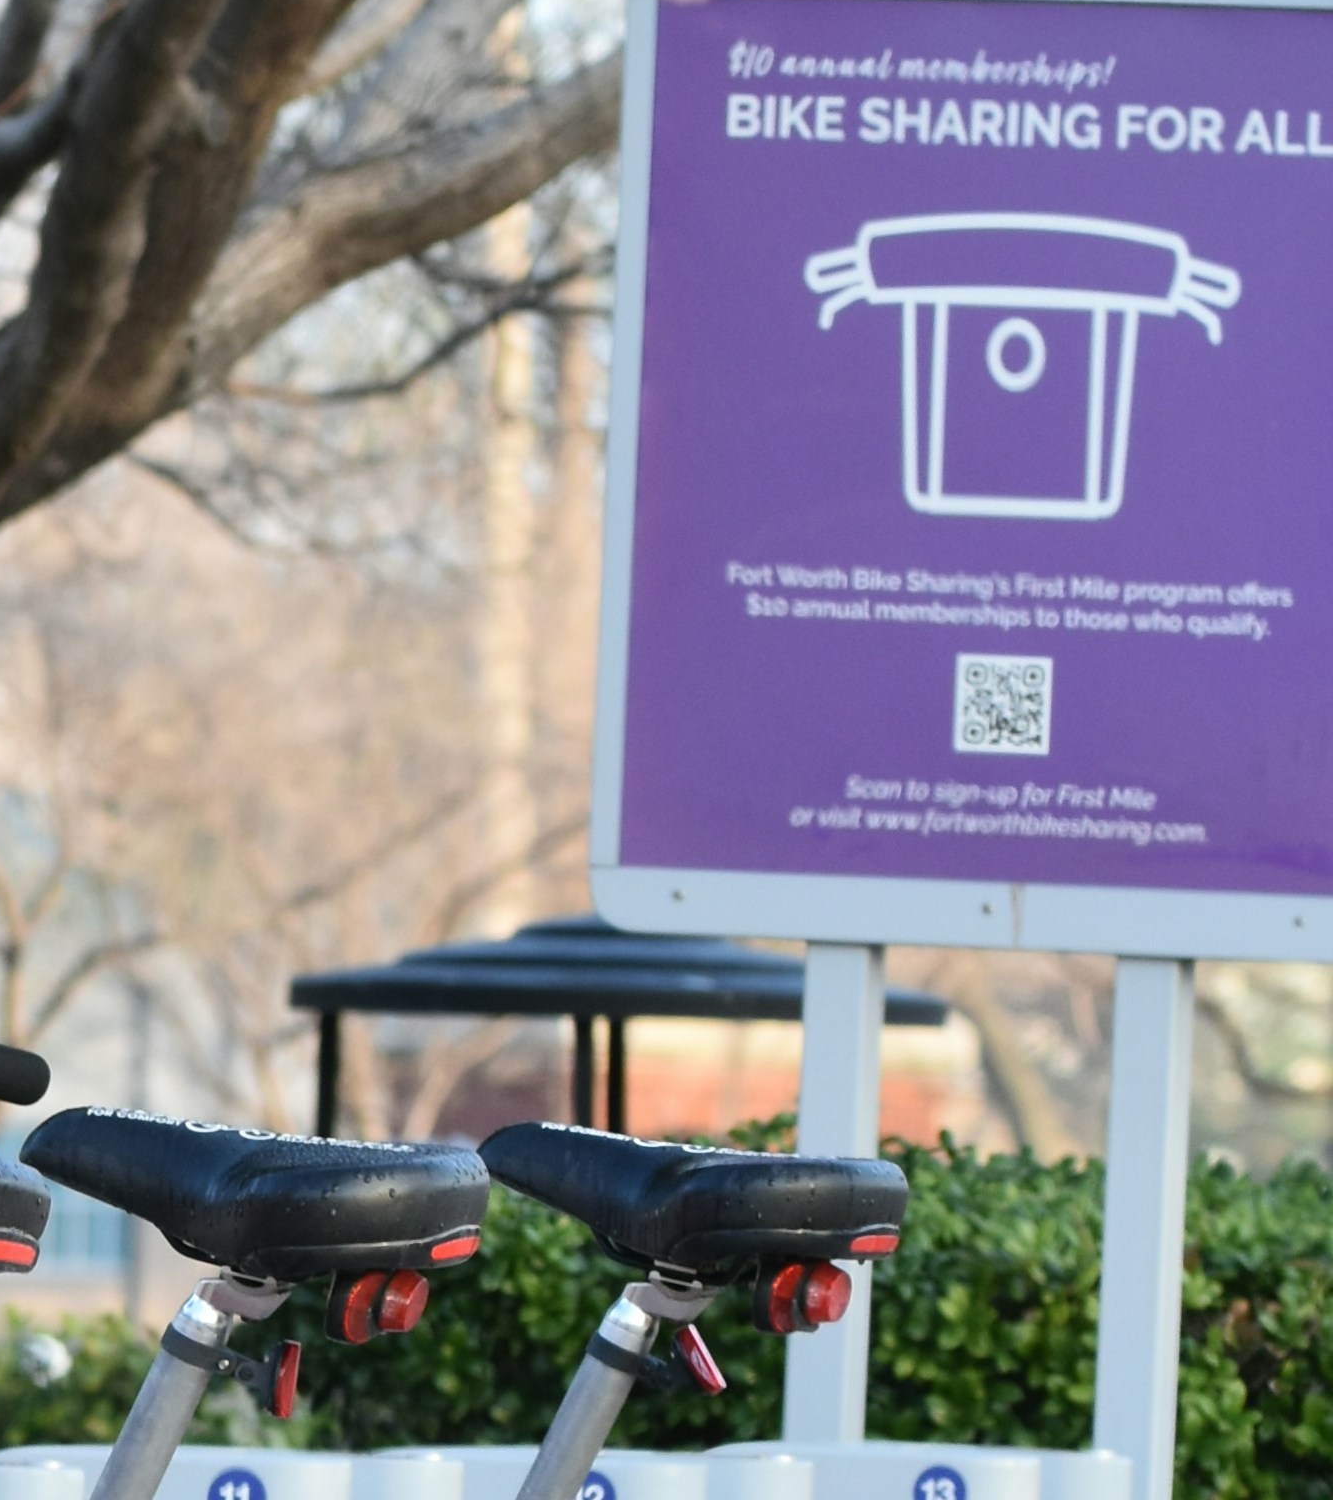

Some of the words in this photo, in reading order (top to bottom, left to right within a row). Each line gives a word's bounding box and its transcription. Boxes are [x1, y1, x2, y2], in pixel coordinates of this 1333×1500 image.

[780, 48, 895, 81] annual
[897, 49, 1117, 94] memberships!
[726, 94, 846, 141] BIKE
[858, 96, 1103, 150] SHARING
[1117, 103, 1224, 153] FOR
[1234, 109, 1333, 157] ALL
[727, 561, 773, 587] Fort
[775, 565, 849, 589] Worth
[851, 567, 903, 592] Bike
[906, 569, 1012, 602] Sharing's
[1014, 572, 1064, 599] First
[1069, 575, 1121, 601] Mile
[1122, 582, 1223, 608] program
[1226, 581, 1293, 608] offers
[791, 598, 871, 621] annual
[874, 601, 1031, 631] memberships
[1034, 607, 1060, 629] to
[1063, 607, 1129, 632] those
[1131, 610, 1184, 633] who
[1186, 612, 1272, 641] qualify.
[845, 774, 902, 801] Scan
[905, 777, 930, 802] to
[933, 780, 1018, 808] sign-up
[1020, 782, 1053, 809] for
[1056, 783, 1106, 810] First
[1109, 787, 1159, 812] Mile
[789, 807, 815, 828] or
[818, 806, 862, 830] visit
